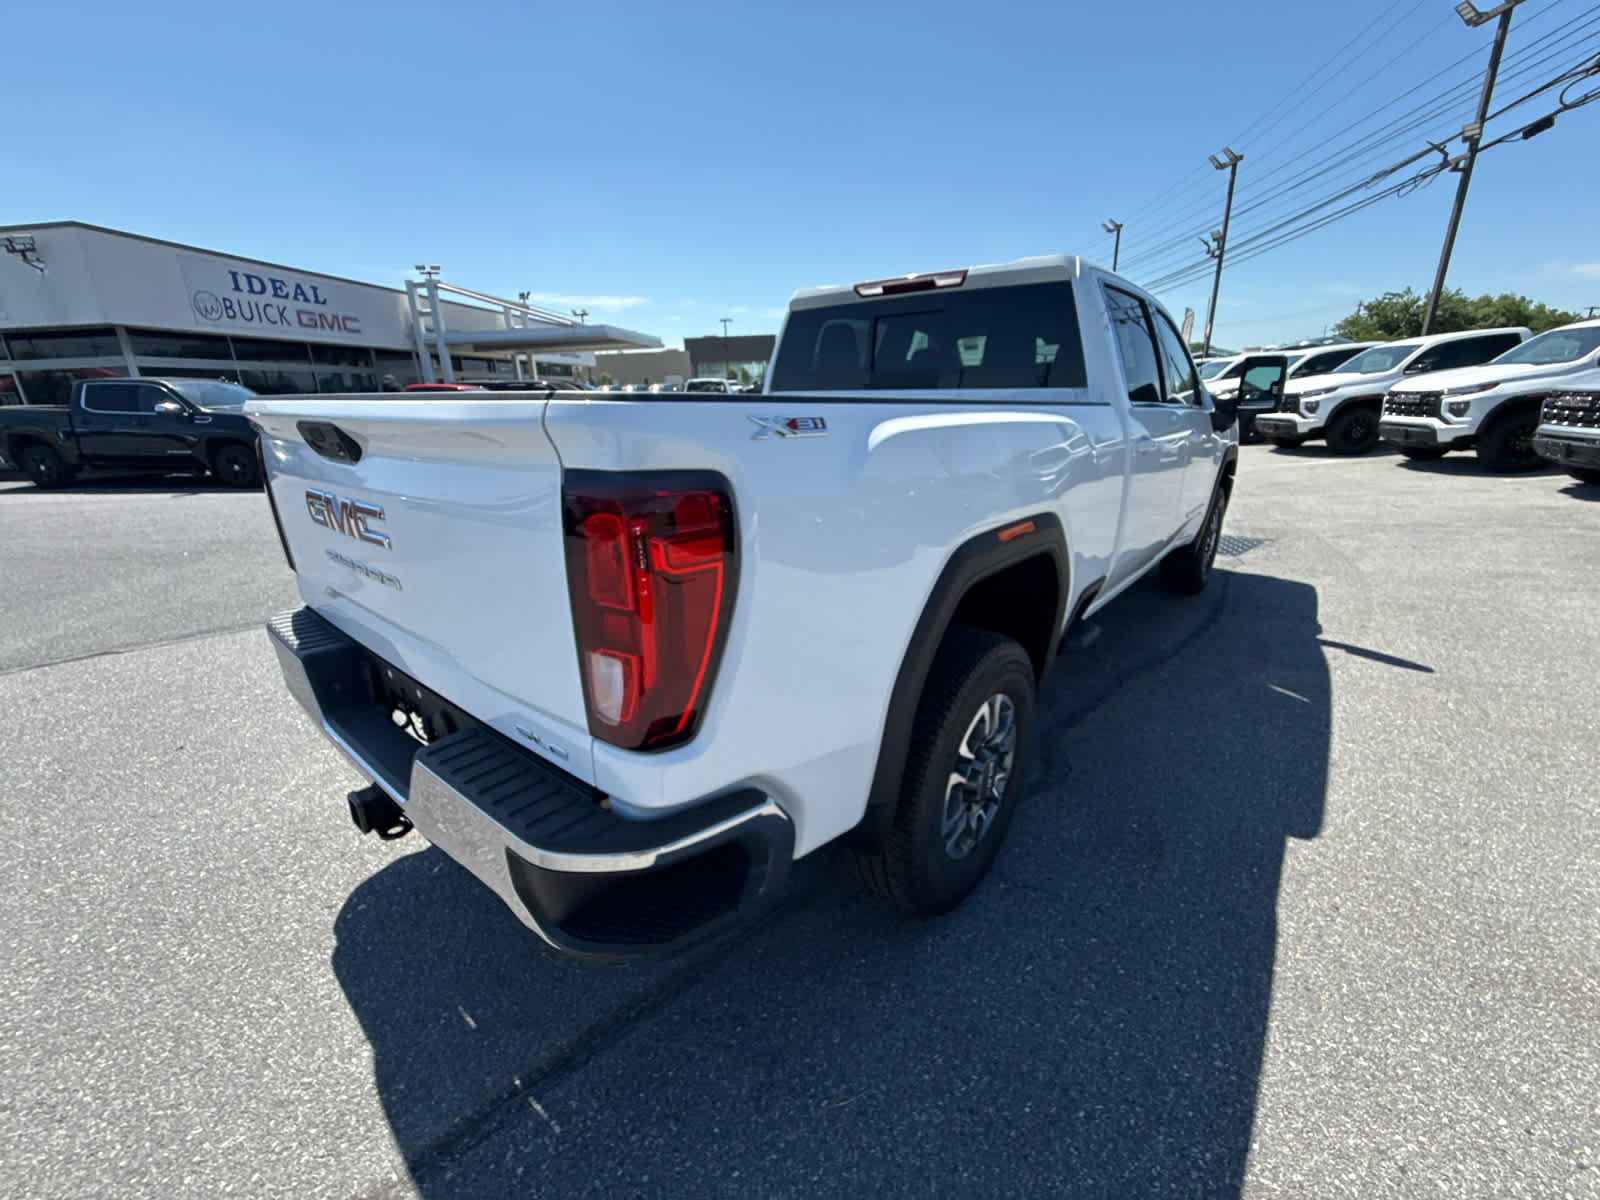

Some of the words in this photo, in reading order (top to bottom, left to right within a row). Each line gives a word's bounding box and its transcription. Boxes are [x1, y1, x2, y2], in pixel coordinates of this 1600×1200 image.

[228, 270, 328, 305] IDEAL
[222, 297, 291, 327] BUICK
[295, 309, 362, 334] GMC
[305, 488, 392, 551] GMC
